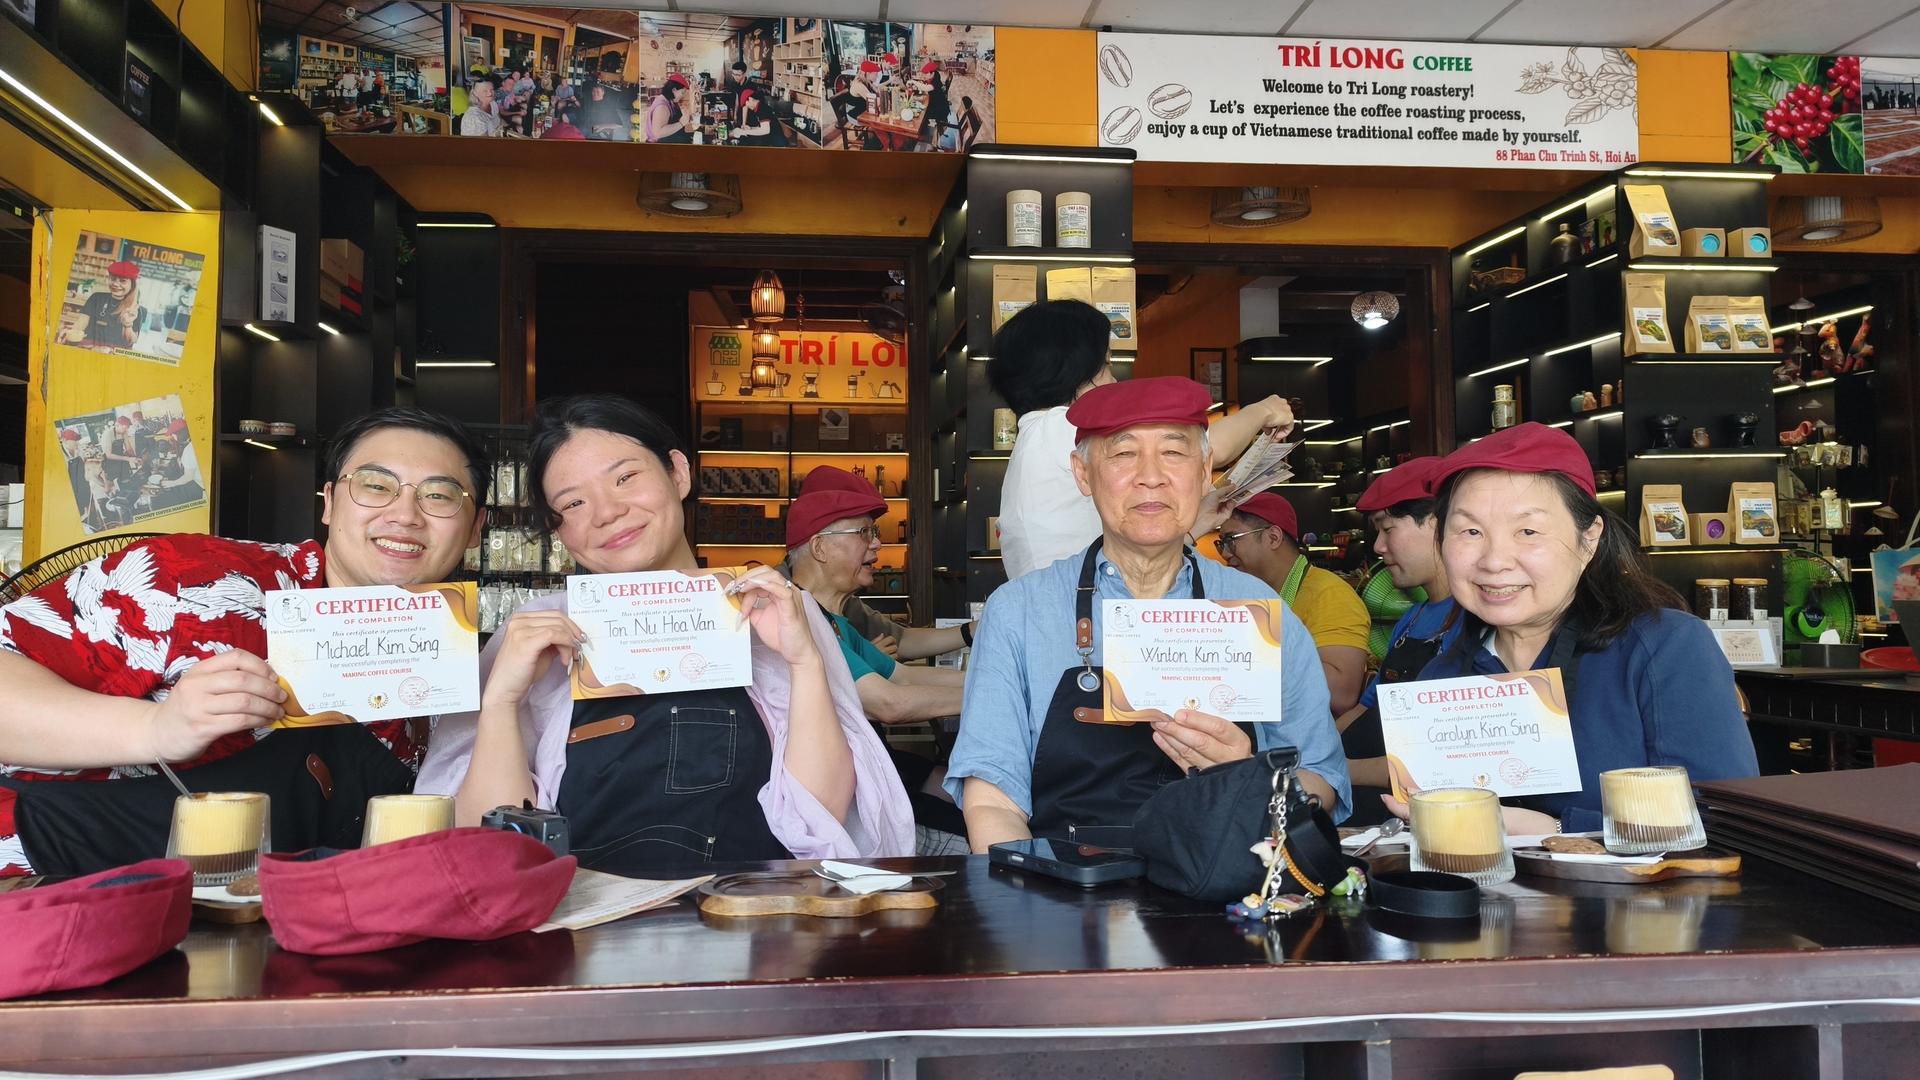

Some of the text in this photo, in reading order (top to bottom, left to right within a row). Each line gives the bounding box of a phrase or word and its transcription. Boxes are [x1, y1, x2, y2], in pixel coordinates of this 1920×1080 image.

[1278, 41, 1473, 72] TRÍ LONG COFFEE
[130, 64, 150, 85] COFFEE
[1262, 79, 1474, 101] Welcome to Tri Long roastery!
[1210, 100, 1526, 123] Let's experience the coffee roasting process,
[1147, 121, 1582, 146] enjoy a cup of Vietnamese traditional coffee made by yourself.
[1496, 150, 1637, 164] 88 Phan Chu Trinh St, Hoi An
[153, 249, 184, 265] LONG
[779, 336, 906, 368] TRÍ LO
[608, 579, 716, 597] CERTIFICATE
[316, 595, 442, 616] CERTIFICATE
[644, 598, 691, 606] COMPLETION
[358, 616, 413, 624] COMPLETION
[604, 612, 716, 638] Ton Nu Hoa Van
[1141, 610, 1249, 624] CERTIFICATE
[345, 629, 379, 637] certificate
[386, 626, 416, 635] presented
[316, 633, 440, 660] Michael Kim Sing
[1140, 645, 1252, 671] Winton Kim Sing
[1417, 682, 1529, 705] CERTIFICATE
[1454, 703, 1504, 712] COMPLETION
[1427, 718, 1540, 746] Carolyn Kim Sing
